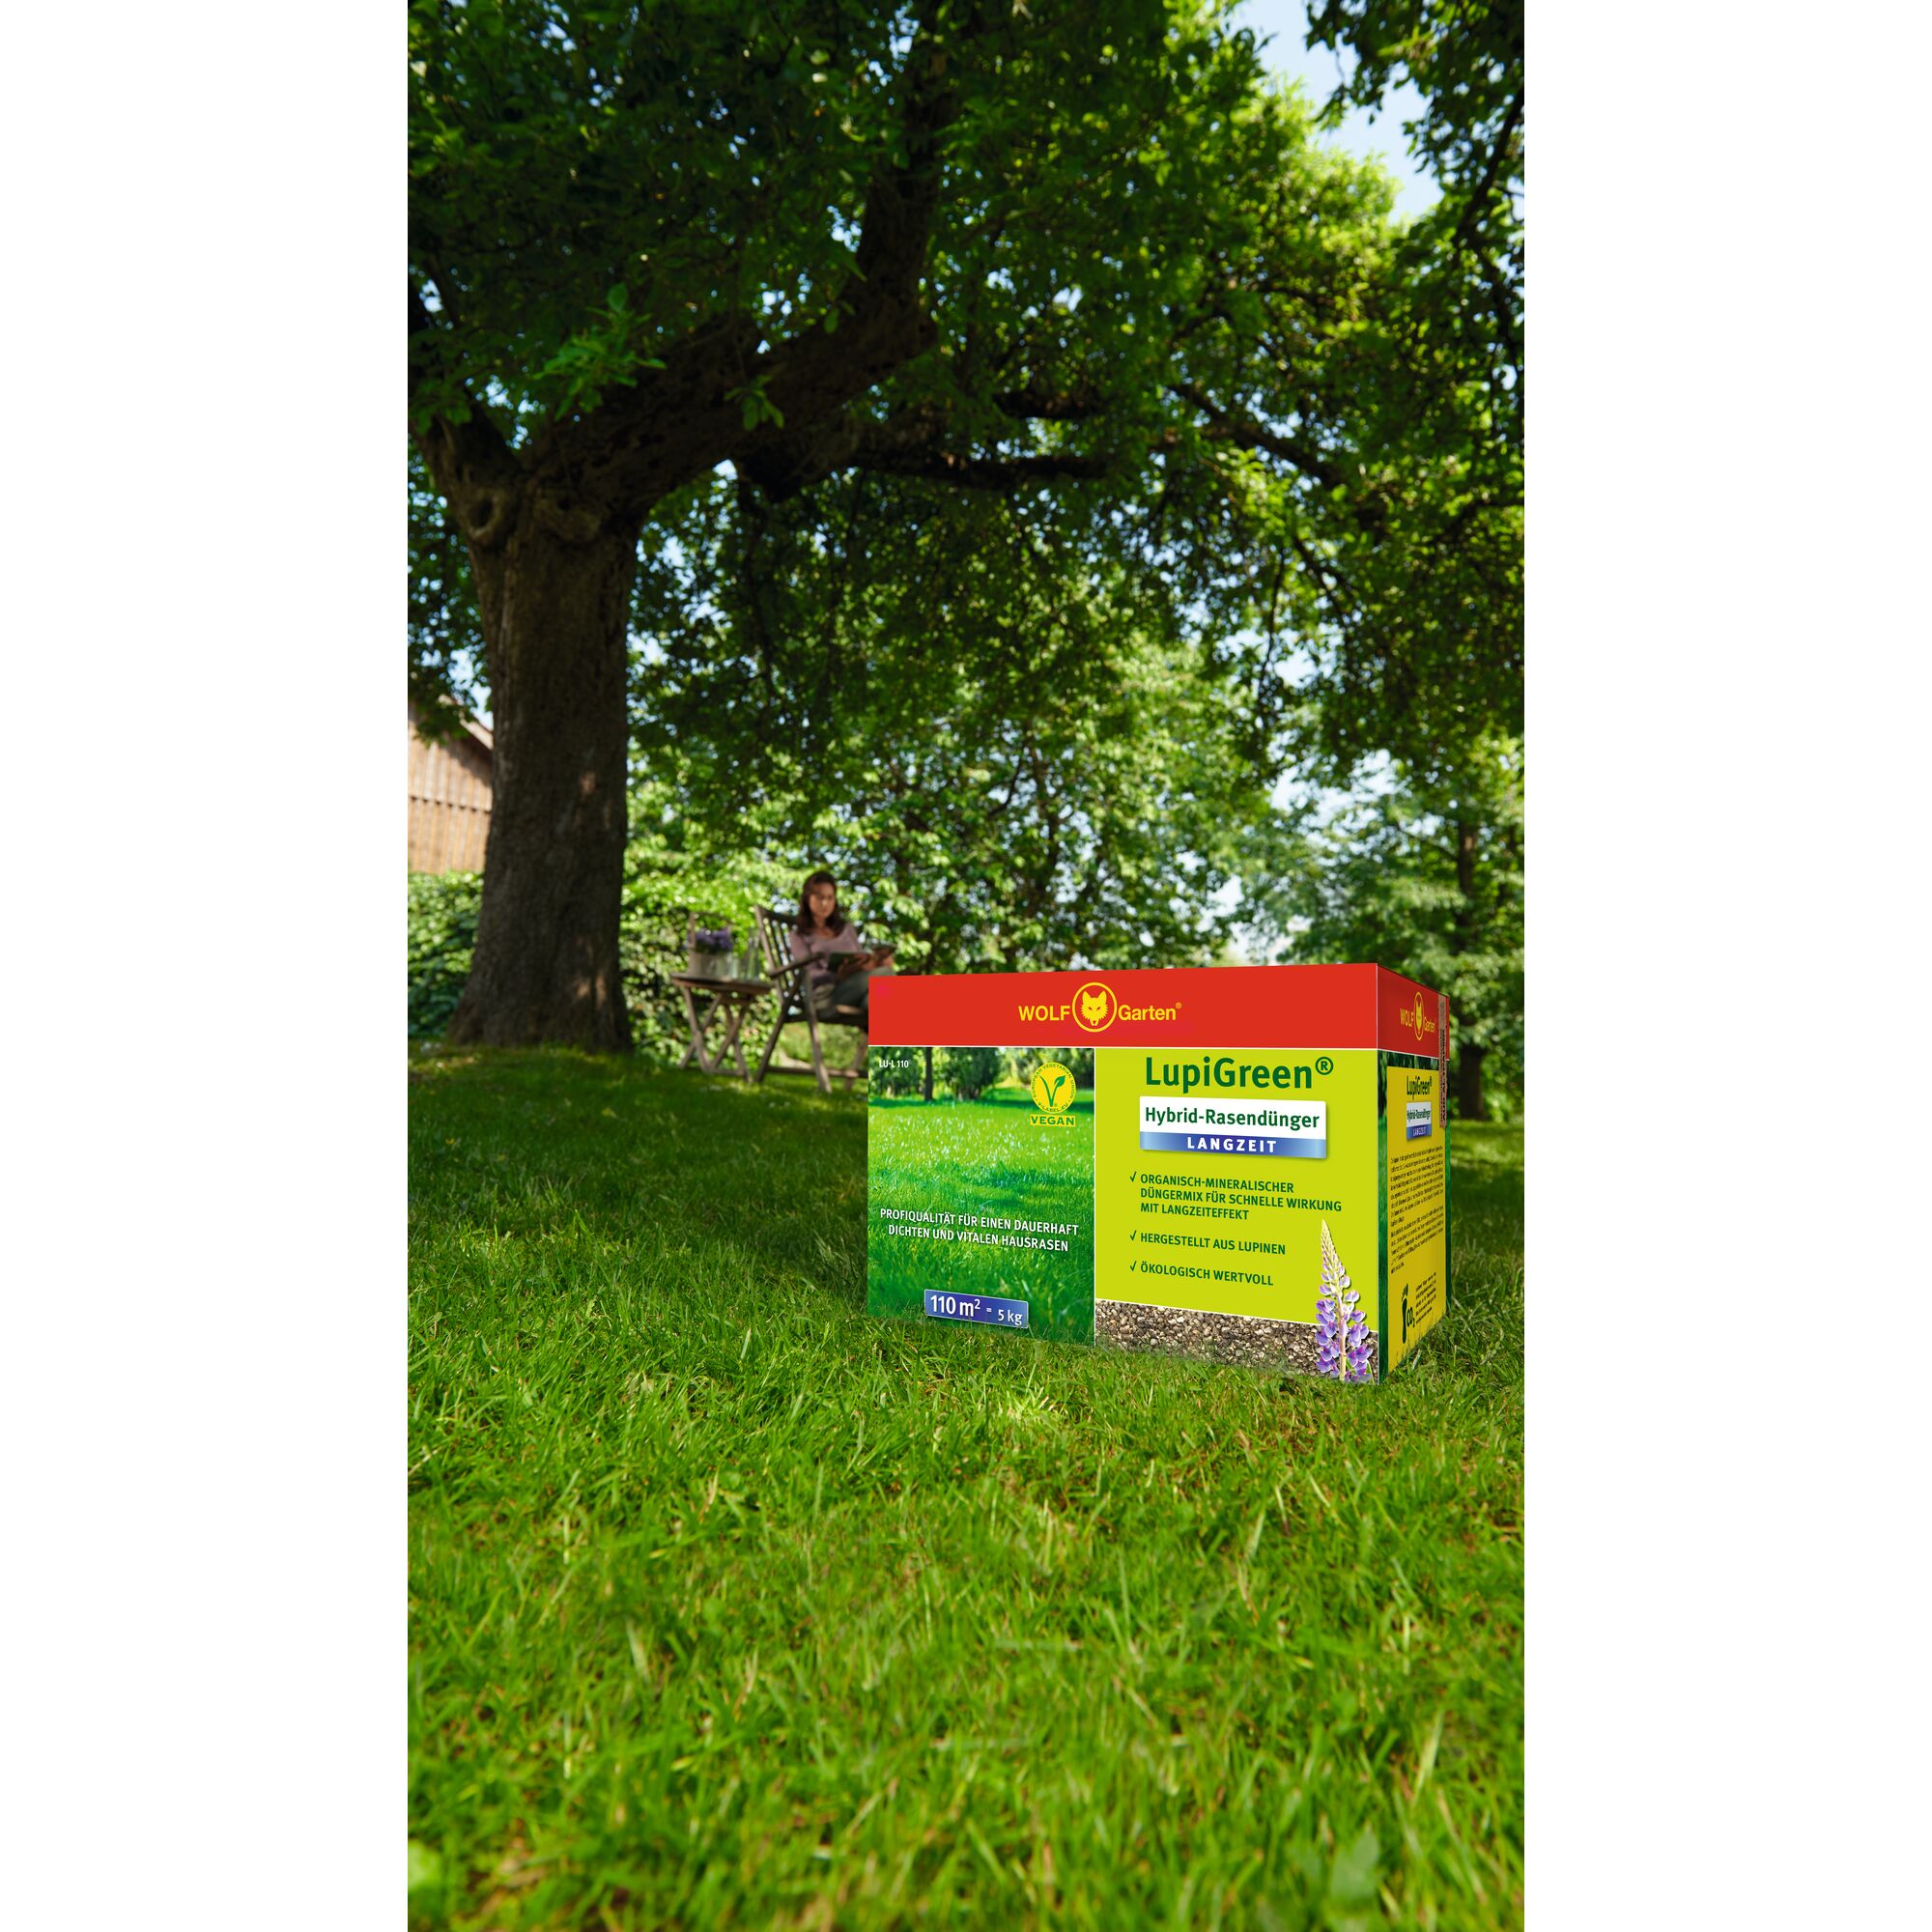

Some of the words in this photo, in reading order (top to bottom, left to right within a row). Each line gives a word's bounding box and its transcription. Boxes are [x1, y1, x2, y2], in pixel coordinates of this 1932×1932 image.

[1018, 1005, 1070, 1021] WOLF
[879, 1059, 895, 1068] LU-L
[896, 1059, 909, 1068] 110
[1031, 1116, 1074, 1125] VEGAN
[1145, 1106, 1321, 1131] Hybrid-Rasendünger
[1187, 1136, 1277, 1153] LANGZEIT
[1140, 1174, 1294, 1193] ORGANISCH-MINERALISCHER
[1140, 1186, 1203, 1202] DÜNGERMIX
[1206, 1191, 1226, 1204] FÜR
[1229, 1194, 1284, 1208] SCHNELLE
[1286, 1198, 1342, 1211] WIRKUNG
[880, 1208, 956, 1225] PROFIQUALITÄT
[958, 1213, 978, 1227] FÜR
[980, 1217, 1011, 1230] EINEN
[1014, 1220, 1079, 1236] DAUERHAFT
[1140, 1203, 1159, 1212] MIT
[1161, 1204, 1249, 1220] LANGZEITEFFEKT
[888, 1225, 930, 1238] DICHTEN
[932, 1230, 954, 1240] UND
[956, 1232, 999, 1245] VITALEN
[1002, 1236, 1068, 1252] HAUSRASEN
[1140, 1233, 1210, 1248] HERGESTELLT
[1213, 1238, 1236, 1250] AUS
[1238, 1240, 1286, 1255] LUPINEN
[1140, 1261, 1210, 1279] ÖKOLOGISCH
[1213, 1269, 1273, 1286] WERTVOLL
[930, 1294, 956, 1314] 110
[998, 1309, 1005, 1321] 5
[1007, 1309, 1023, 1326] kg
